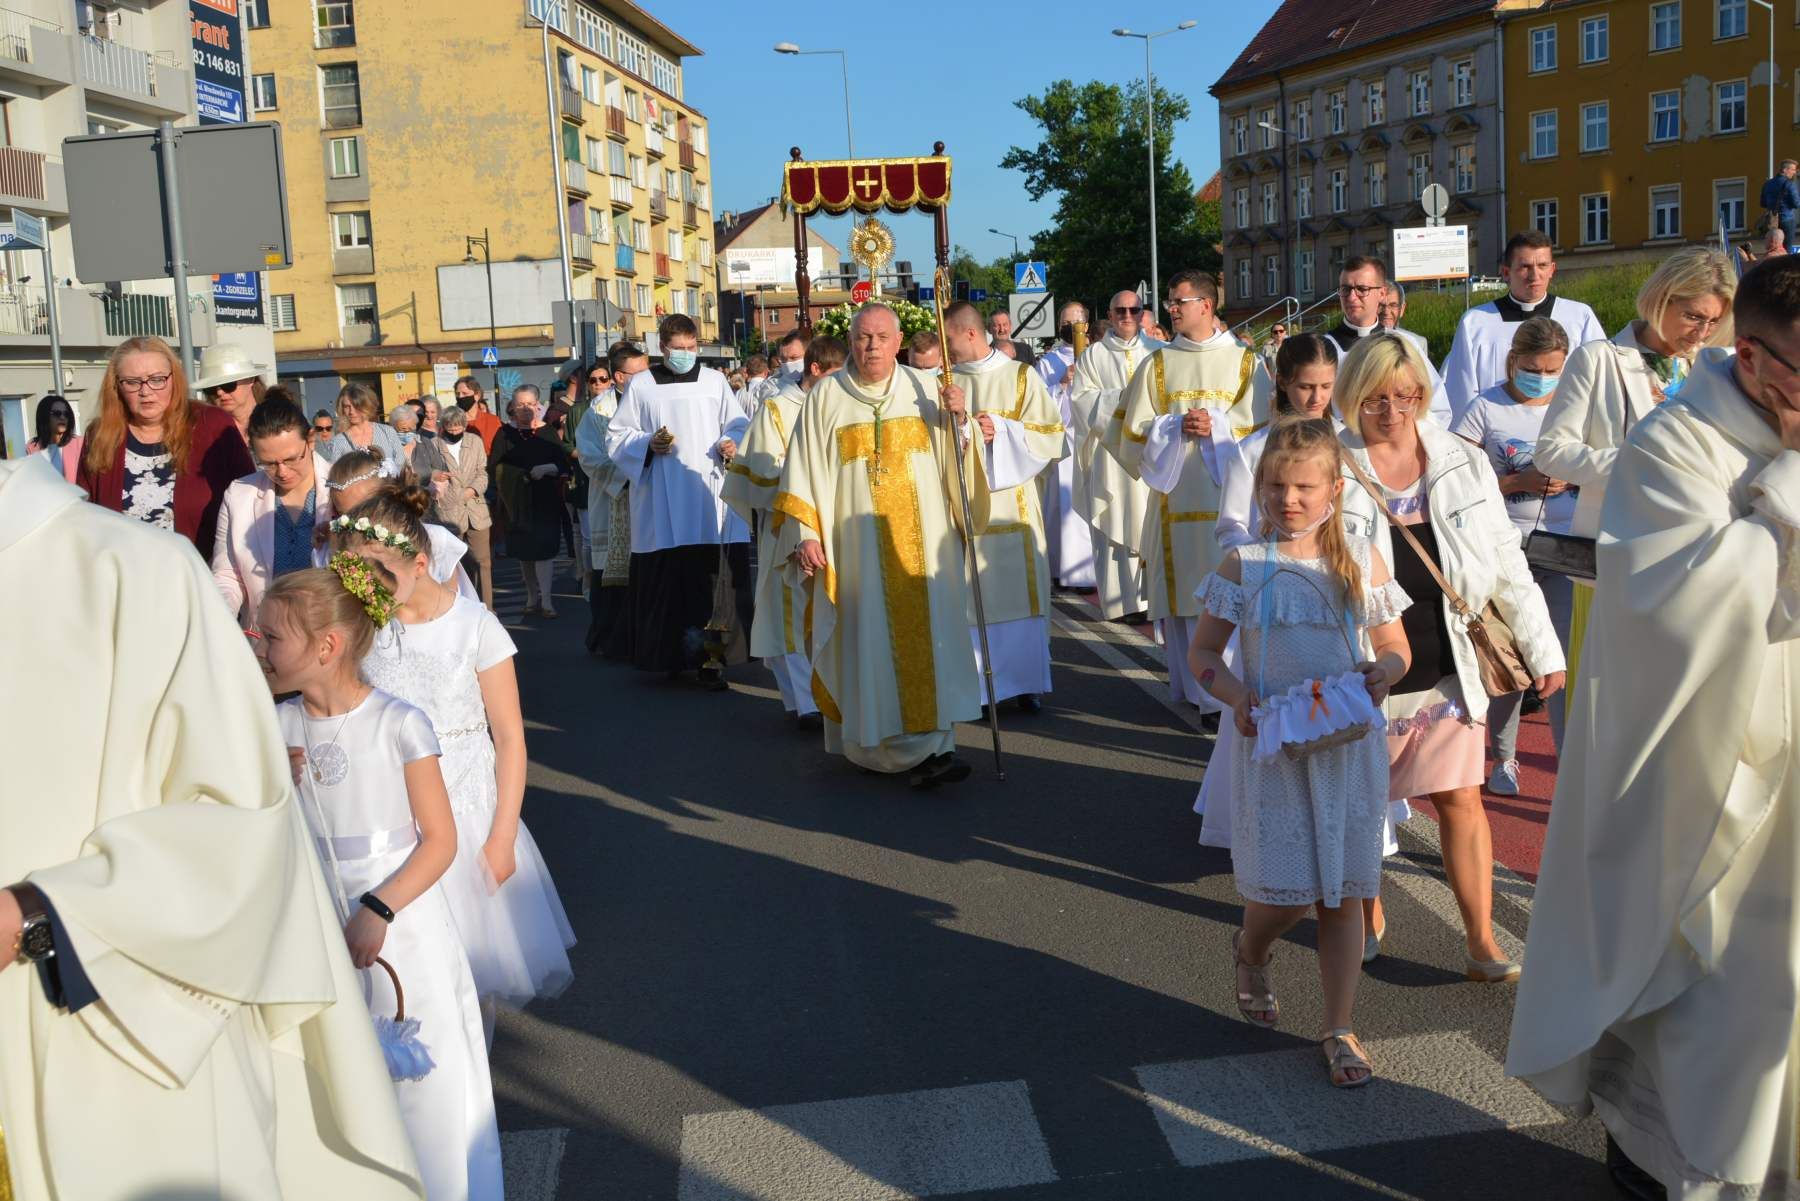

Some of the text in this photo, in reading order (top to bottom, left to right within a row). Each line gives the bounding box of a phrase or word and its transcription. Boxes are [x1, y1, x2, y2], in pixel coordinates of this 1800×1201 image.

[206, 53, 223, 71] 146
[225, 59, 241, 77] 831
[226, 285, 255, 296] ZGORZELEC
